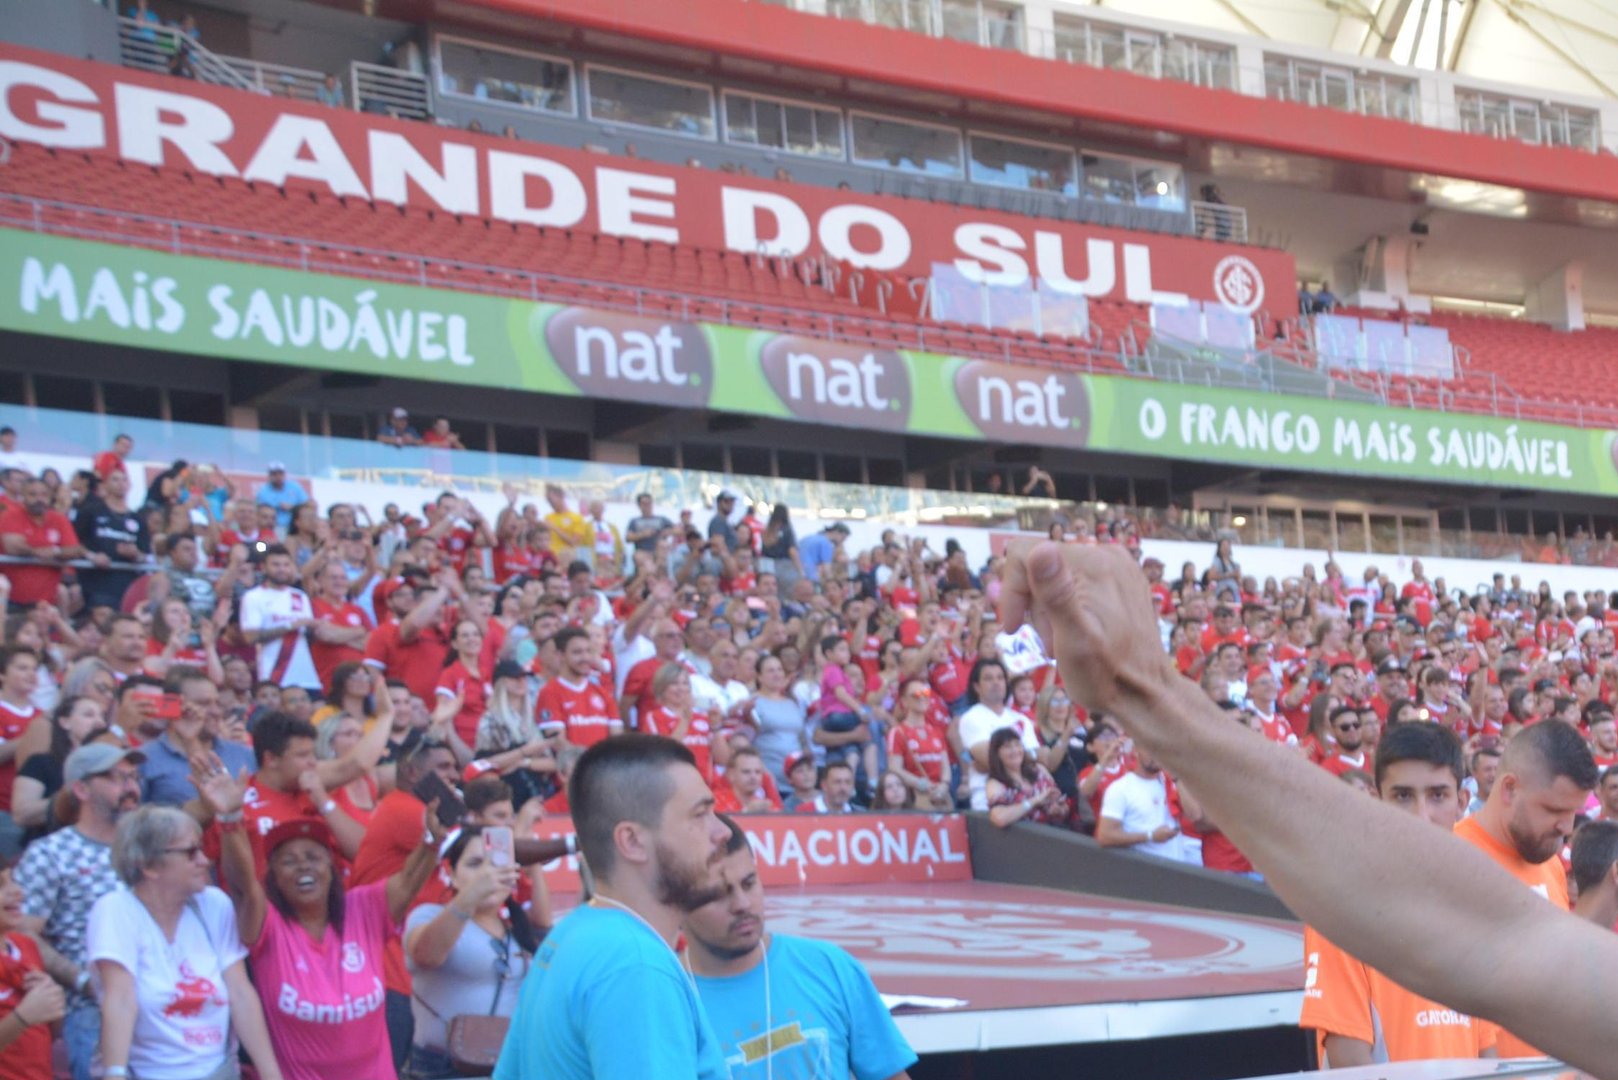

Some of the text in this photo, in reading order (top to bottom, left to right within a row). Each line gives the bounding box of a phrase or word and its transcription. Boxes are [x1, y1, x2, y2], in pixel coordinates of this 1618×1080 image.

[0, 60, 1189, 306] GRANDE DO SUL
[207, 286, 474, 366] SAUDÁVEL
[1140, 399, 1167, 439] O
[1180, 402, 1320, 453] FRANGO
[1429, 426, 1572, 478] SAUDÁVEL
[746, 828, 965, 867] NACIONAL
[278, 975, 385, 1023] Banrisul
